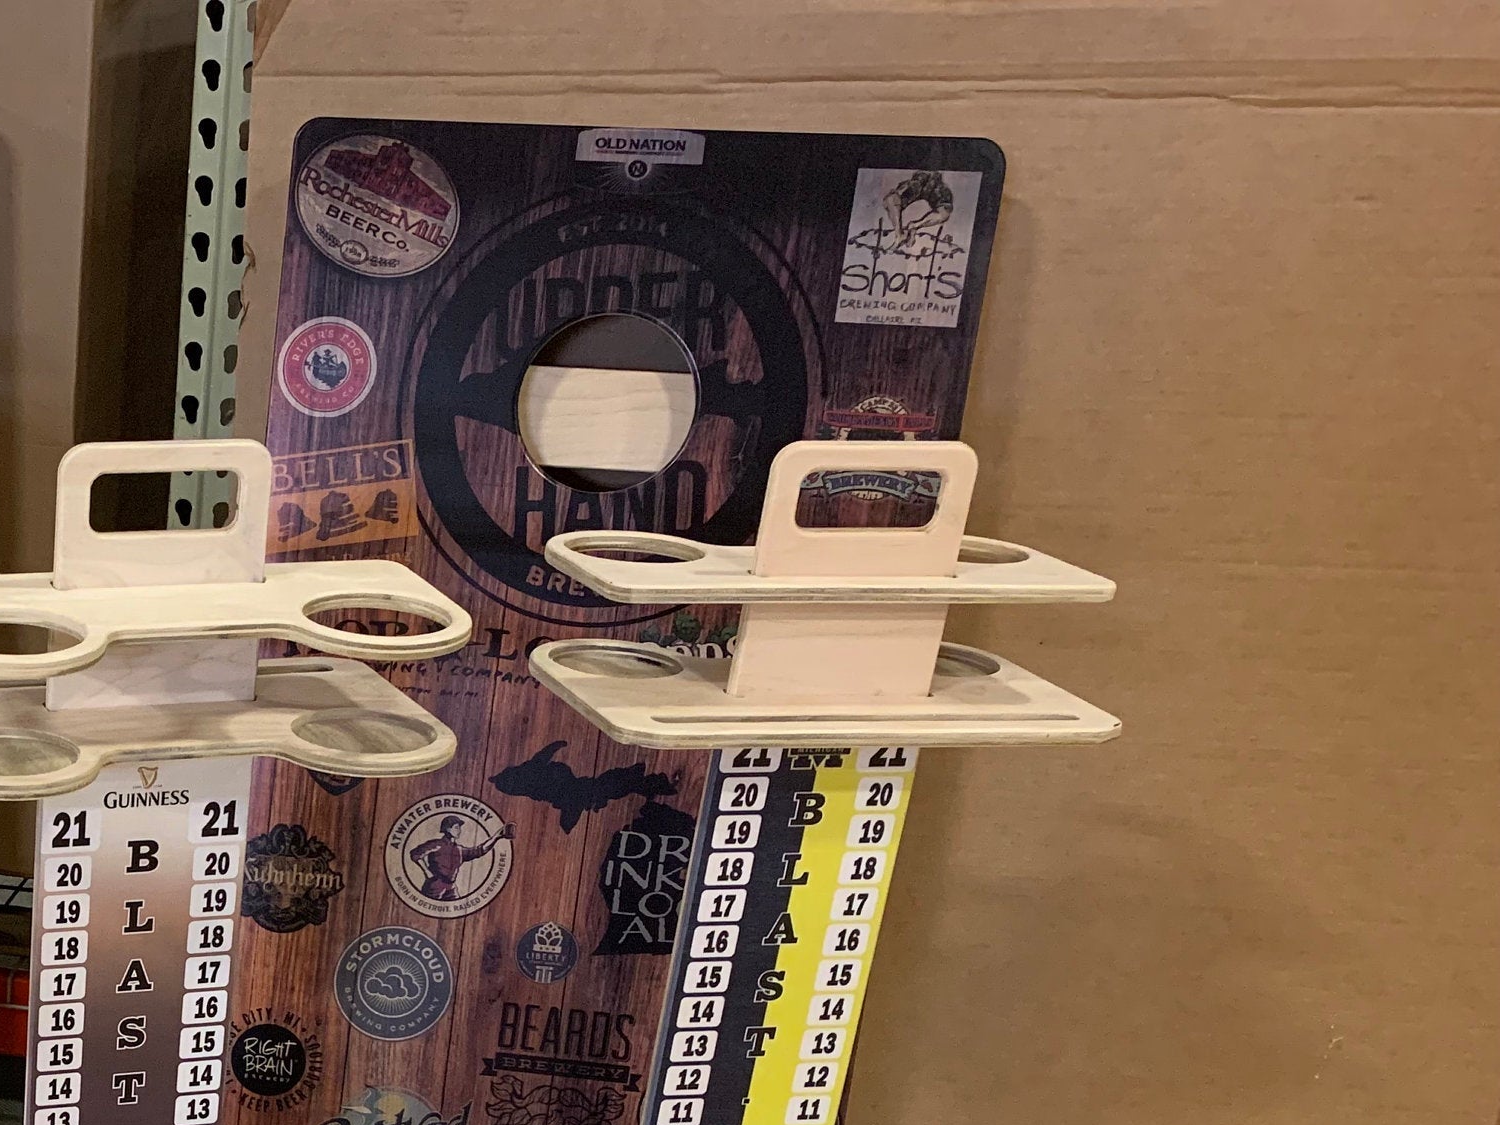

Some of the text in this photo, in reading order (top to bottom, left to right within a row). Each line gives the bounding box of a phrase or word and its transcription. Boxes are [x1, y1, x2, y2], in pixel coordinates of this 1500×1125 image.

[595, 137, 687, 152] OLD NATION
[325, 203, 380, 238] BEER
[841, 263, 964, 299] Short's
[272, 448, 403, 493] BELL'S
[829, 473, 911, 494] BREWERY
[103, 789, 190, 810] GUINNESS
[730, 782, 759, 808] 20
[865, 782, 894, 807] 20
[51, 810, 91, 849] 21
[201, 799, 240, 838] 21
[390, 798, 494, 850] ATWATER BREWERY
[56, 862, 83, 888] 20
[204, 850, 231, 876] 20
[710, 894, 737, 918] 17
[842, 893, 869, 916] 17
[53, 936, 79, 961] 18
[199, 924, 225, 949] 18
[345, 932, 445, 983] STORMCLOUD
[525, 951, 567, 963] LIBERTY
[191, 1030, 216, 1054] 15
[497, 1001, 636, 1063] BEARDS
[811, 1032, 838, 1055] 13
[49, 1043, 74, 1067] 15
[243, 1036, 298, 1059] RIGHT
[682, 1034, 709, 1057] 13
[242, 1053, 293, 1076] BRAIN
[499, 1056, 626, 1079] BREWERY
